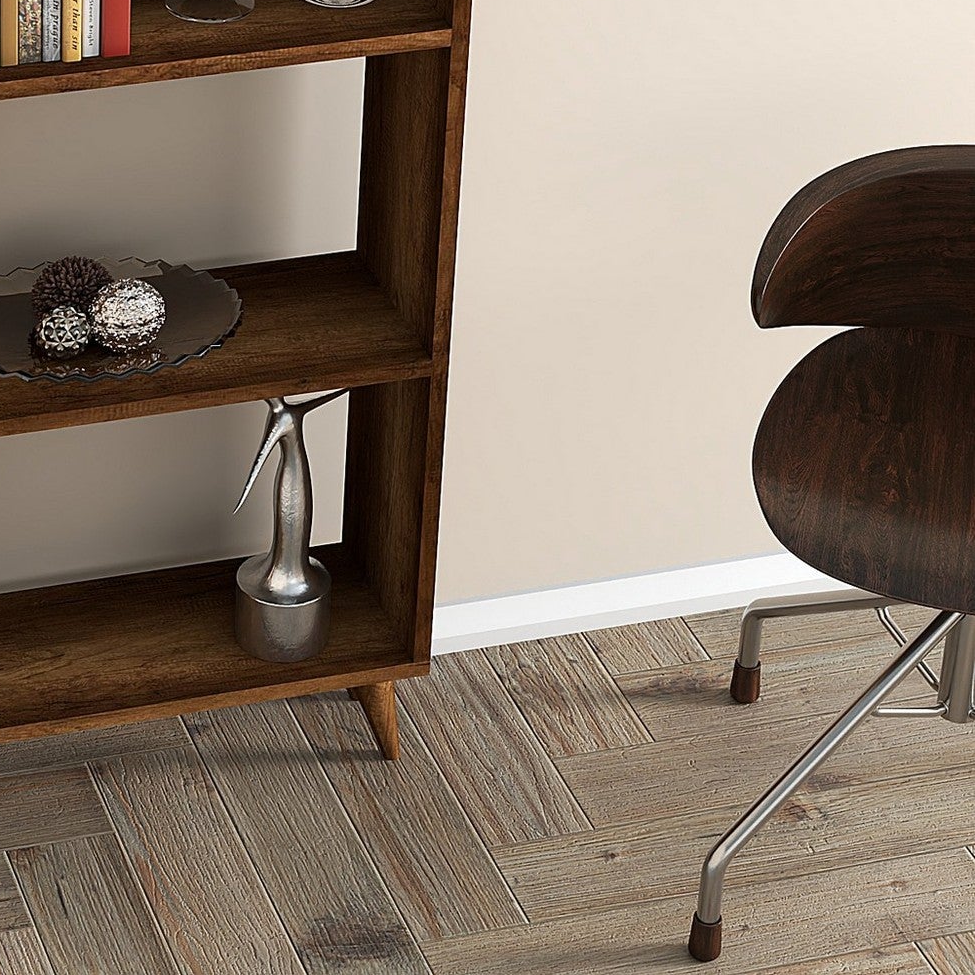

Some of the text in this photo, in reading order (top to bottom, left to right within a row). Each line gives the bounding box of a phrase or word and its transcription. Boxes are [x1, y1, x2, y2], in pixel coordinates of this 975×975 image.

[53, 0, 60, 11] in
[72, 8, 80, 30] than
[49, 15, 60, 49] prague
